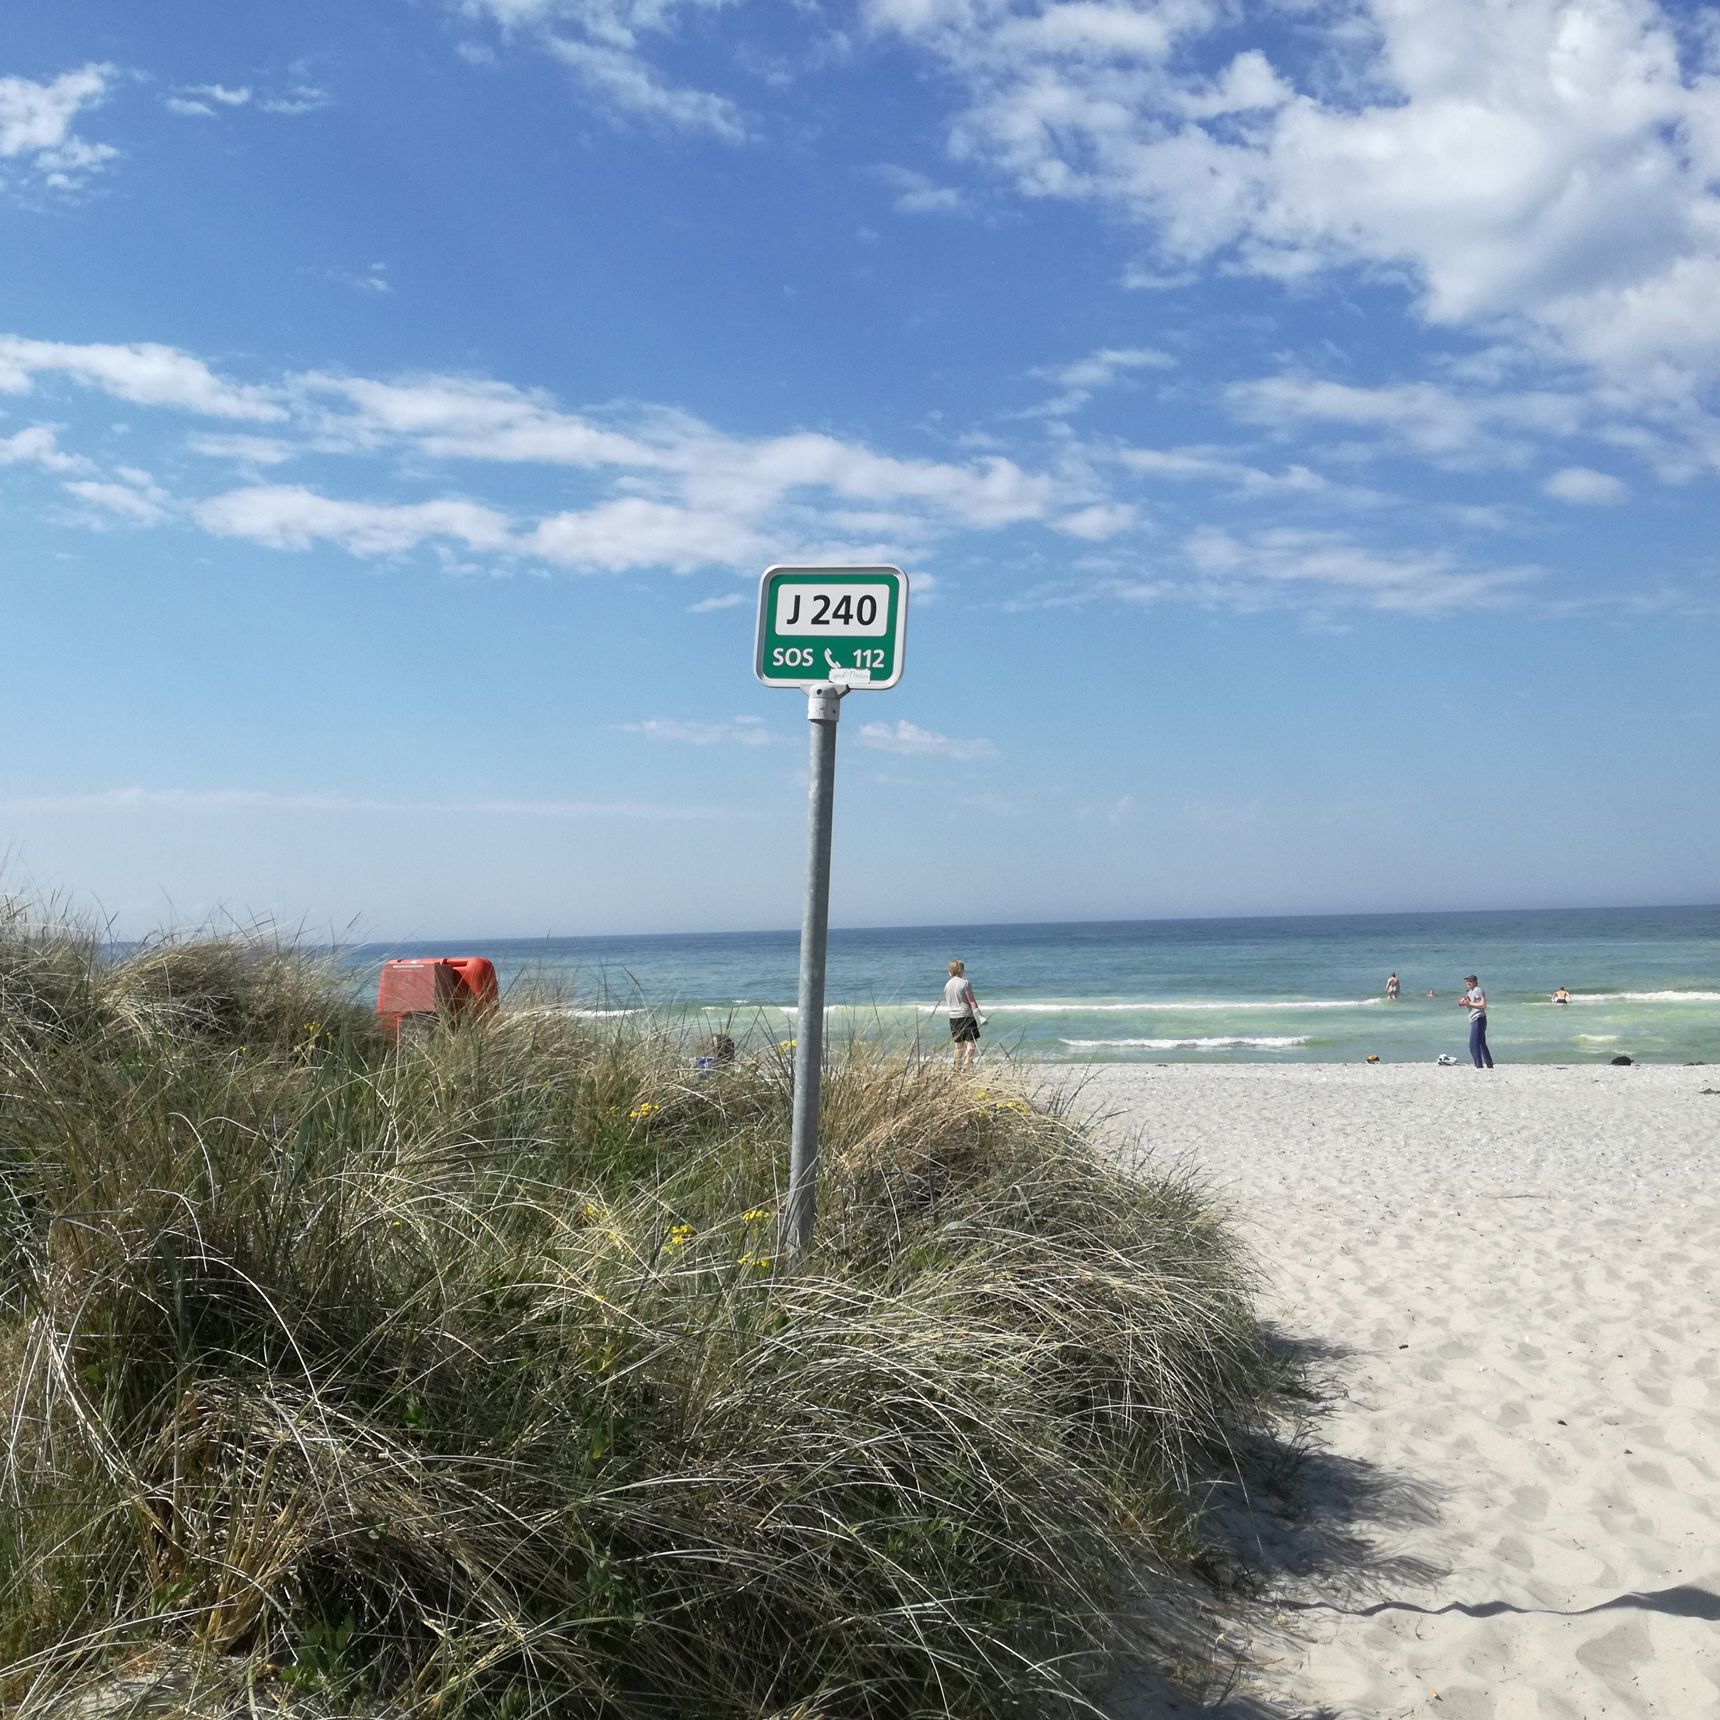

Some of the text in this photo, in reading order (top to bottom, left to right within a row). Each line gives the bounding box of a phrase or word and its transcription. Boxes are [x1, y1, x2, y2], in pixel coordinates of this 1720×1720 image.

[786, 594, 877, 626] J 240
[772, 647, 885, 668] SOS 112
